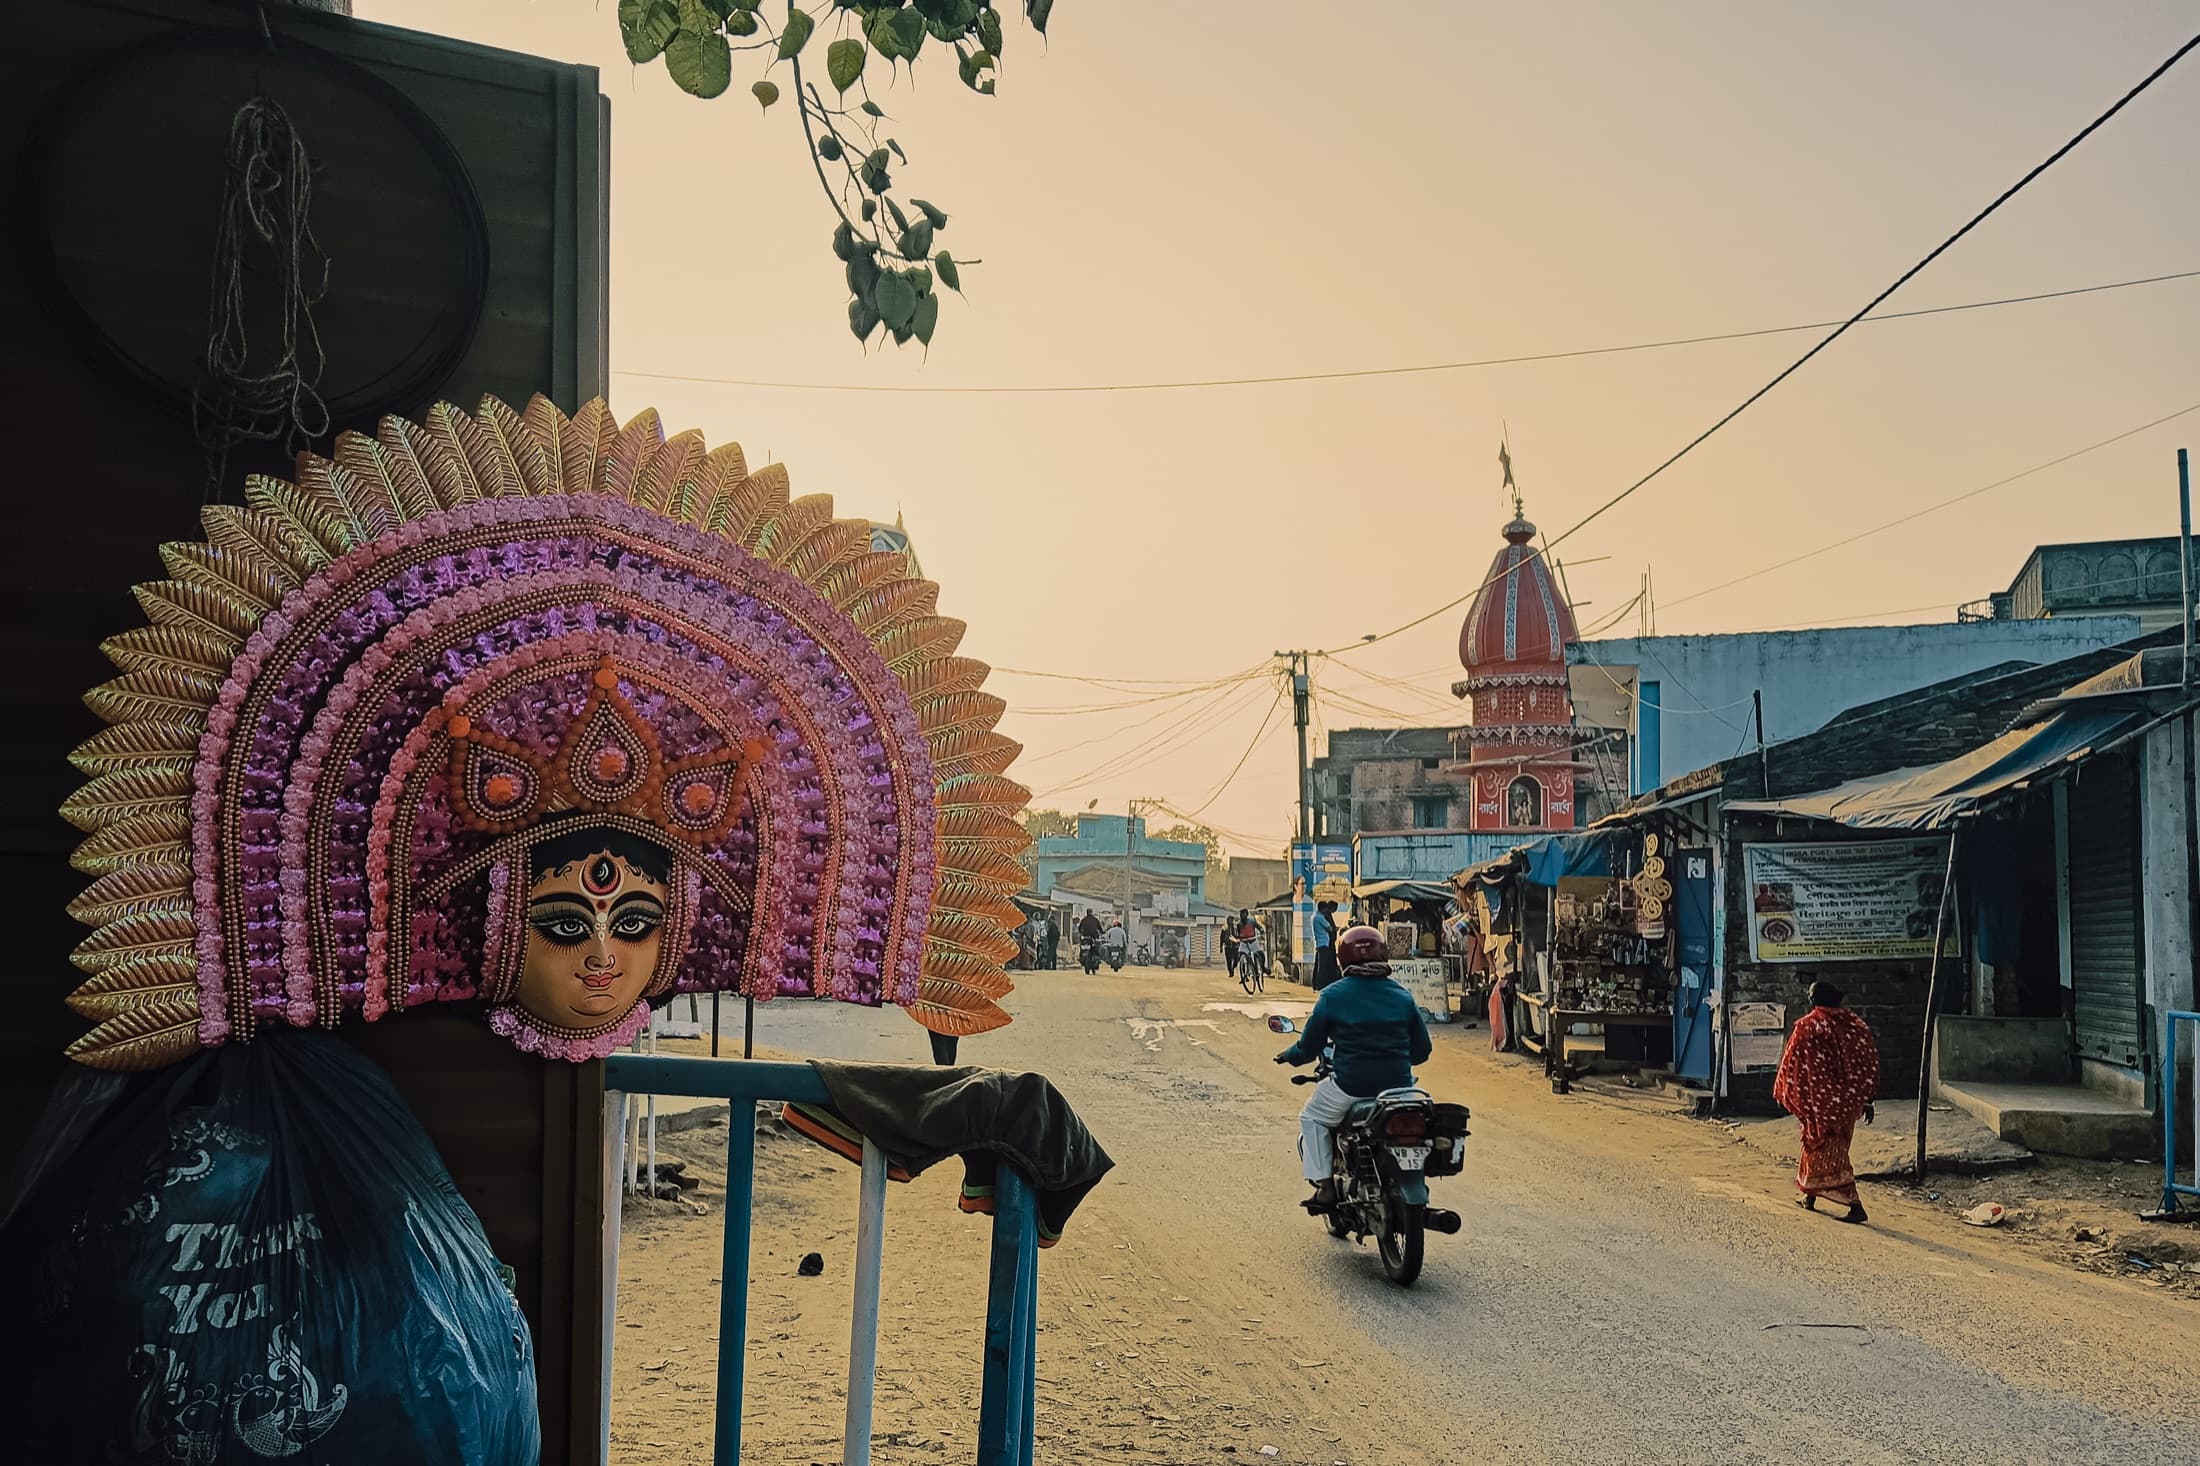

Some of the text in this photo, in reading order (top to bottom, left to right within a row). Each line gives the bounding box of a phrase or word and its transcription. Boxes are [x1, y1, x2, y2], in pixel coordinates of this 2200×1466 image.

[1798, 908, 1850, 920] Heritage
[1853, 908, 1866, 917] of
[1870, 906, 1912, 919] Bengal
